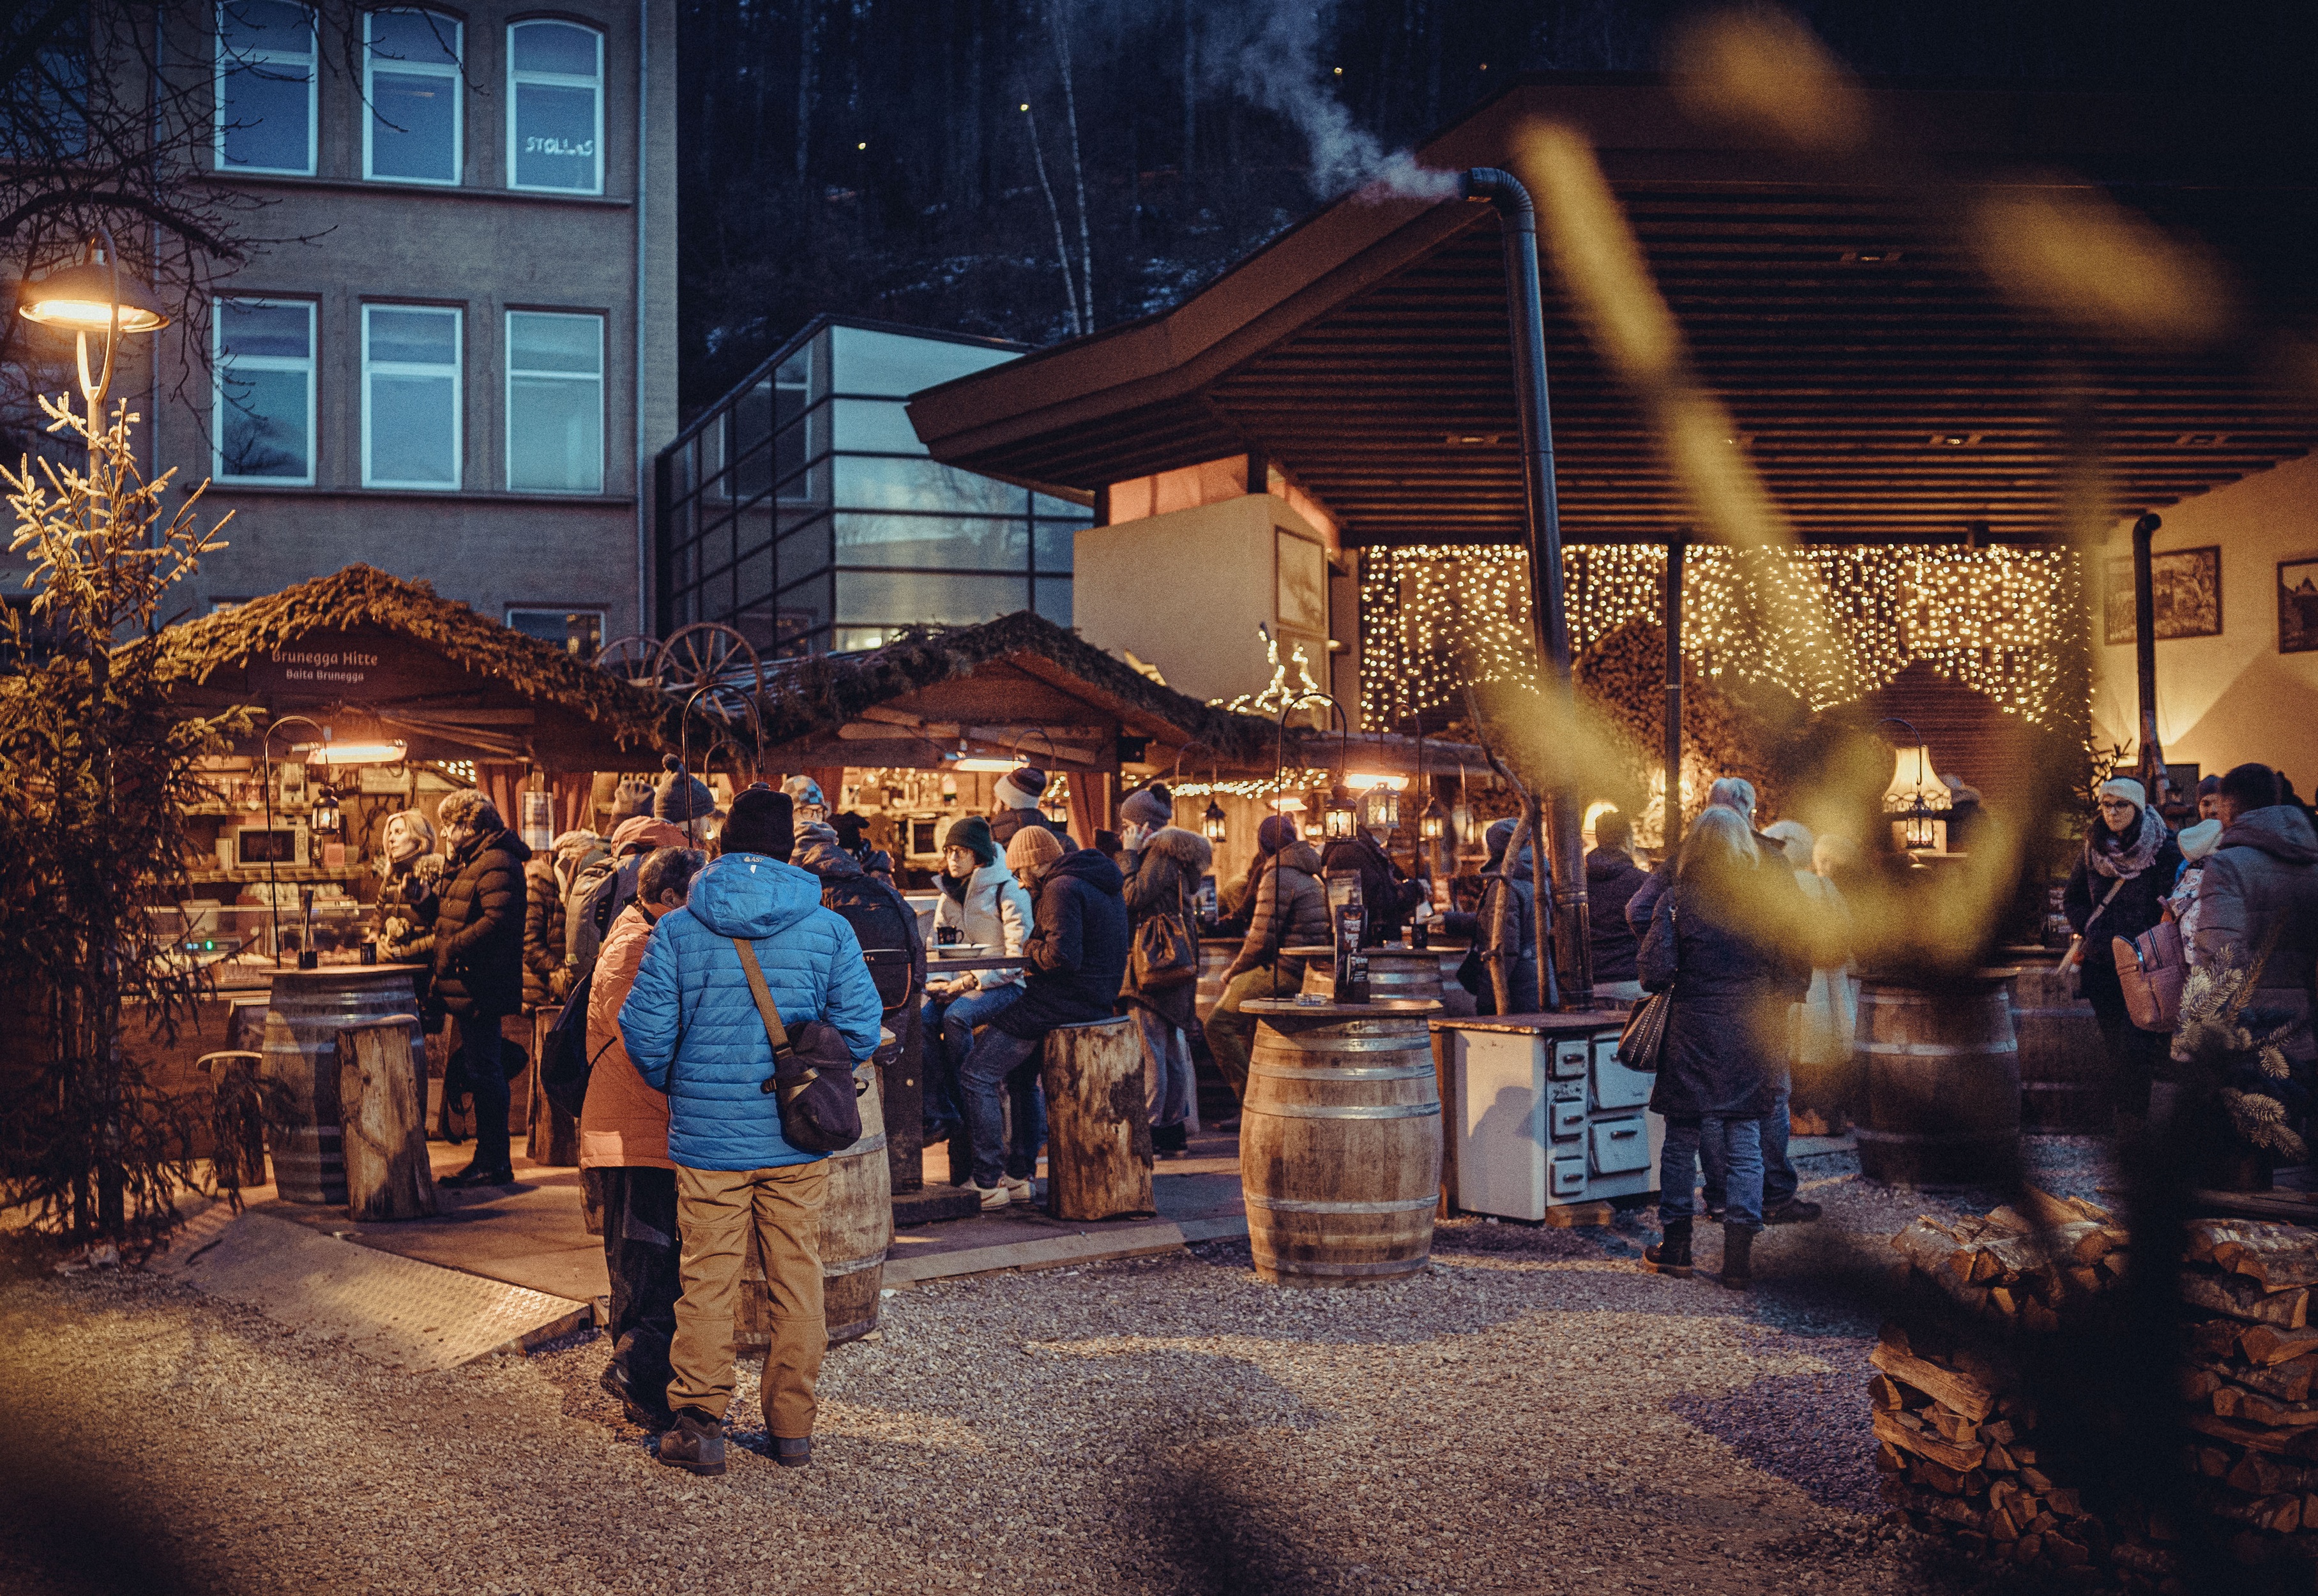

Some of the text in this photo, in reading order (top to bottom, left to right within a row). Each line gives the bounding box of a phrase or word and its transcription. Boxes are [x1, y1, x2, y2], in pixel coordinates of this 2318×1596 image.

[343, 650, 378, 666] Hitte
[286, 668, 365, 683] Baita Brunegga
